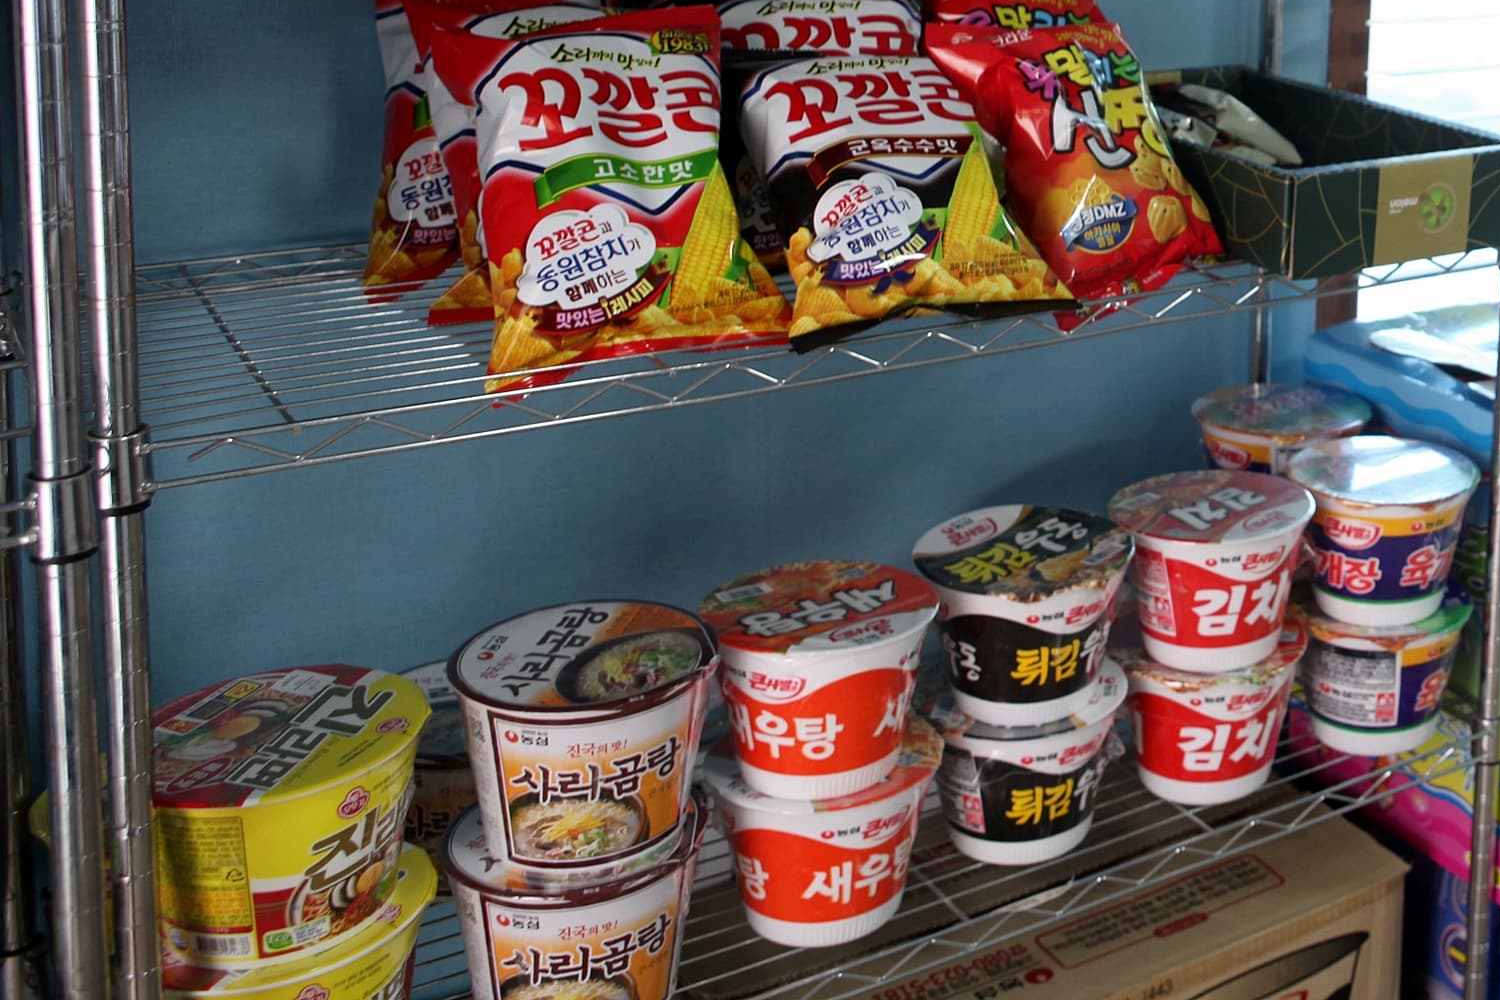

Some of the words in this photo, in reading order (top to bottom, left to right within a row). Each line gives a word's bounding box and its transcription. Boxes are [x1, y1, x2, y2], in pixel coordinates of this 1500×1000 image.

[499, 66, 720, 152] 꼬깔콘
[764, 69, 977, 144] 꼬깔콘
[740, 580, 897, 638] 새우탕
[1191, 569, 1291, 637] 김치
[500, 606, 610, 698] 사리곰탕
[224, 684, 395, 790] 진라면
[511, 735, 683, 806] 사리곰탕
[521, 734, 549, 747] 농심
[1177, 709, 1278, 772] 김치
[503, 911, 672, 986] 사리곰탕
